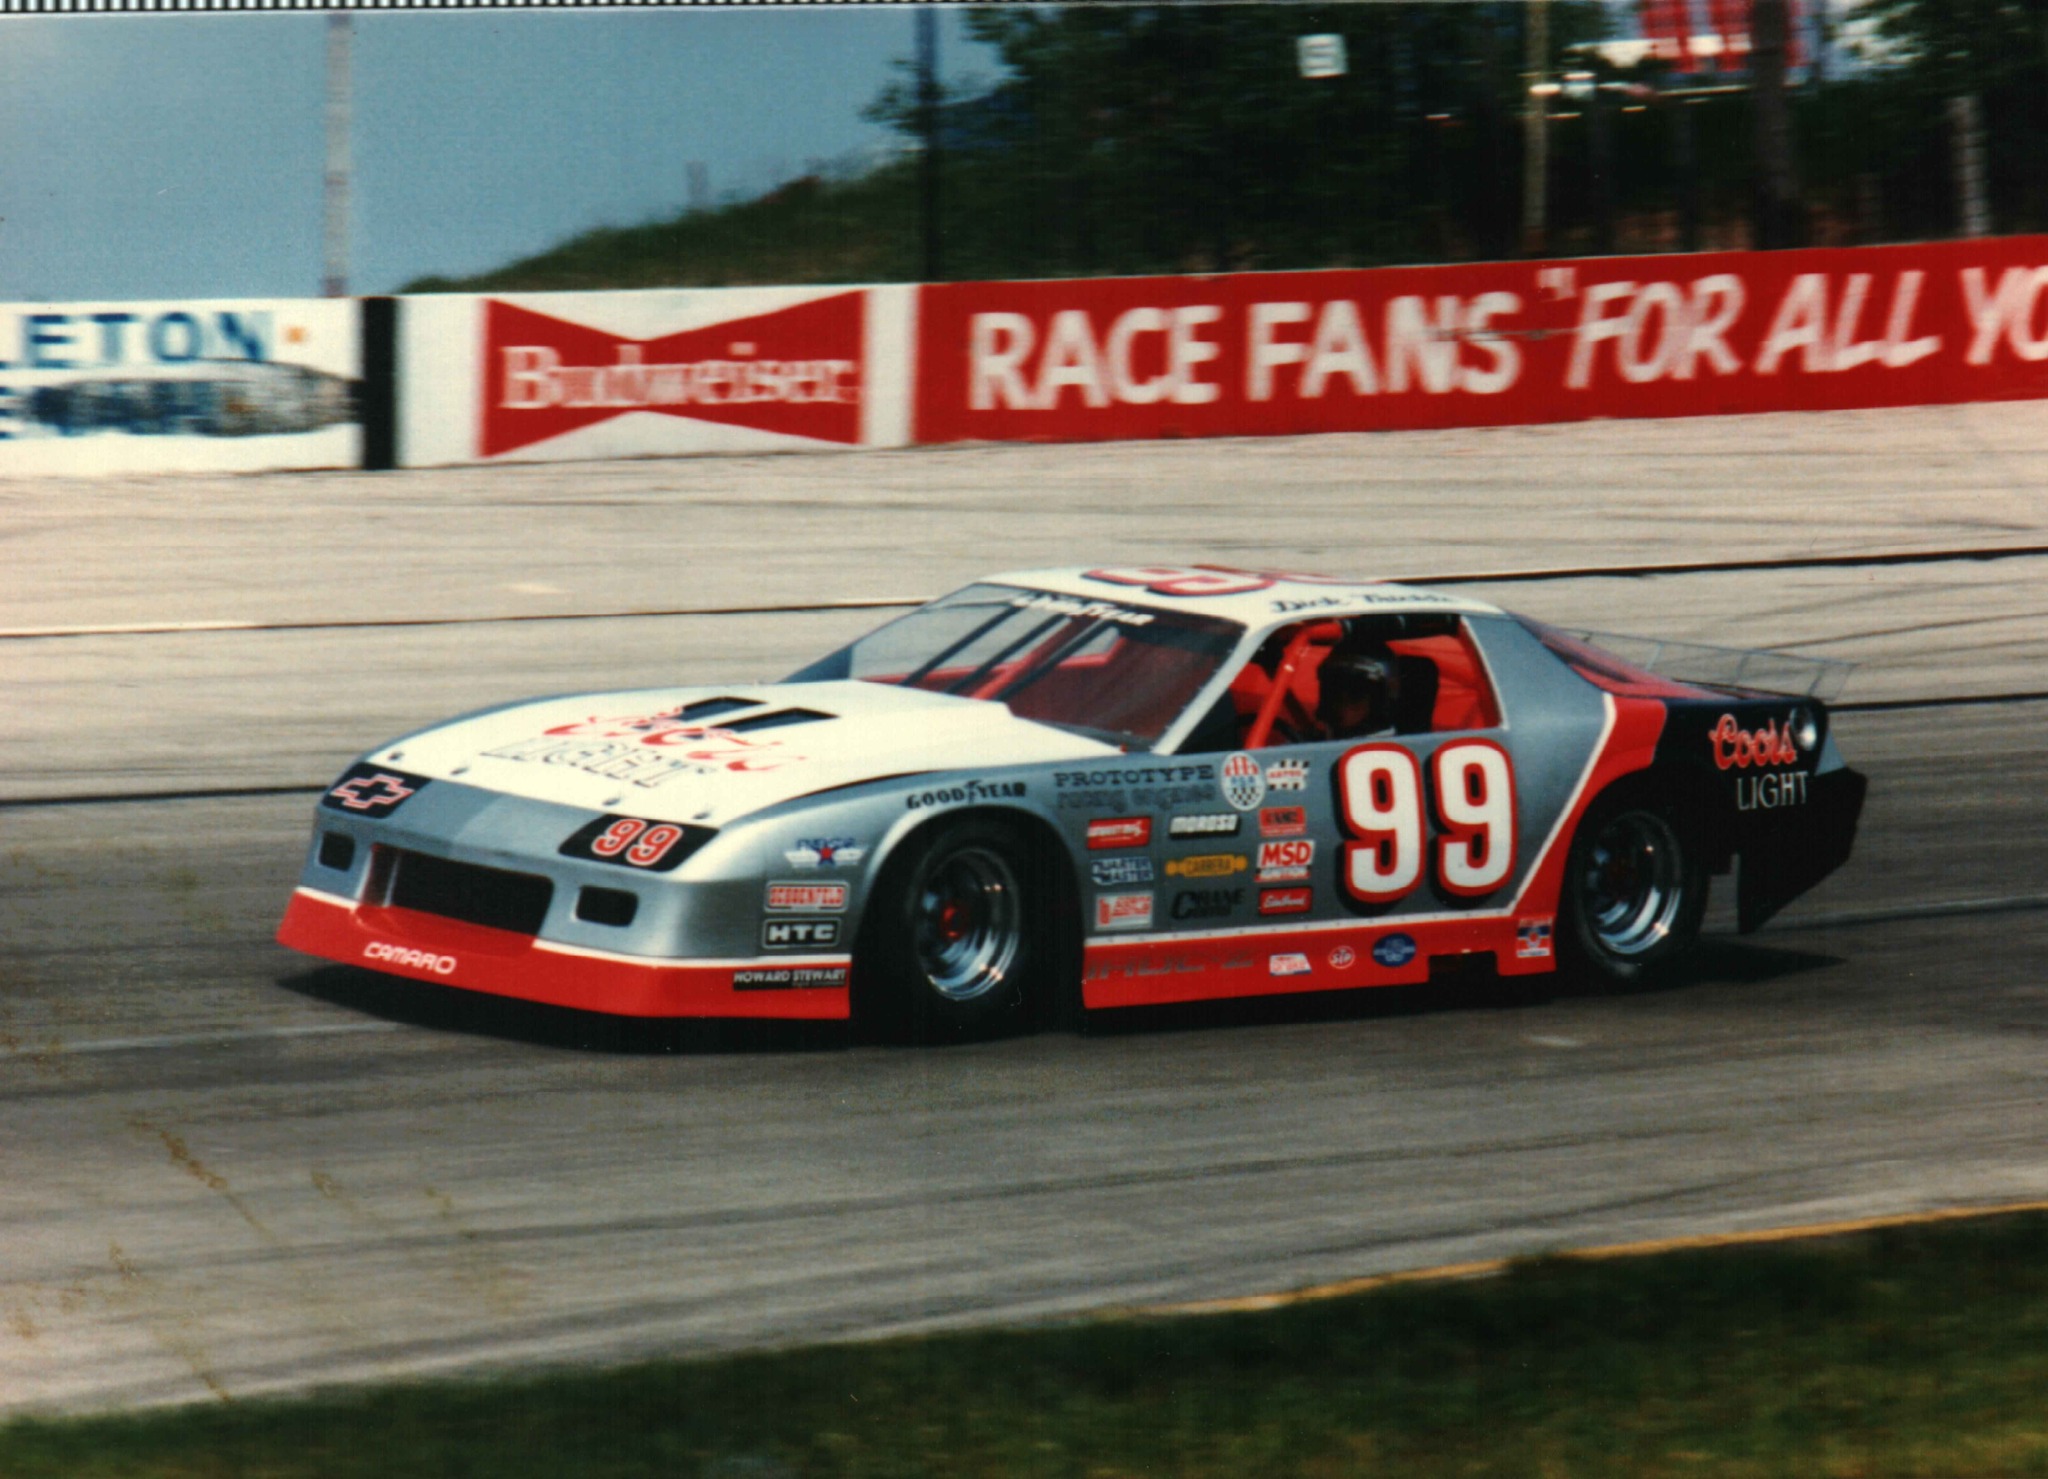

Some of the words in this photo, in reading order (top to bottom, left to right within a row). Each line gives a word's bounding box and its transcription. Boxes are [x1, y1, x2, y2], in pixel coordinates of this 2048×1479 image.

[0, 310, 273, 368] ETON
[969, 305, 1221, 411] RACE
[1247, 290, 1522, 398] FANS
[1758, 269, 1942, 374] ALL
[499, 341, 862, 411] Budweiser
[1709, 713, 1797, 770] Coors
[906, 779, 1026, 810] GOODYEAR
[1054, 765, 1215, 788] PROTOTYPE
[1736, 771, 1809, 811] LIGHT
[591, 818, 682, 866] 99
[1336, 742, 1518, 904] 99
[1261, 841, 1312, 867] MSD
[769, 924, 836, 942] HTC
[364, 941, 456, 975] CAMARO
[733, 970, 791, 983] HOWARD
[792, 968, 846, 982] STEWART
